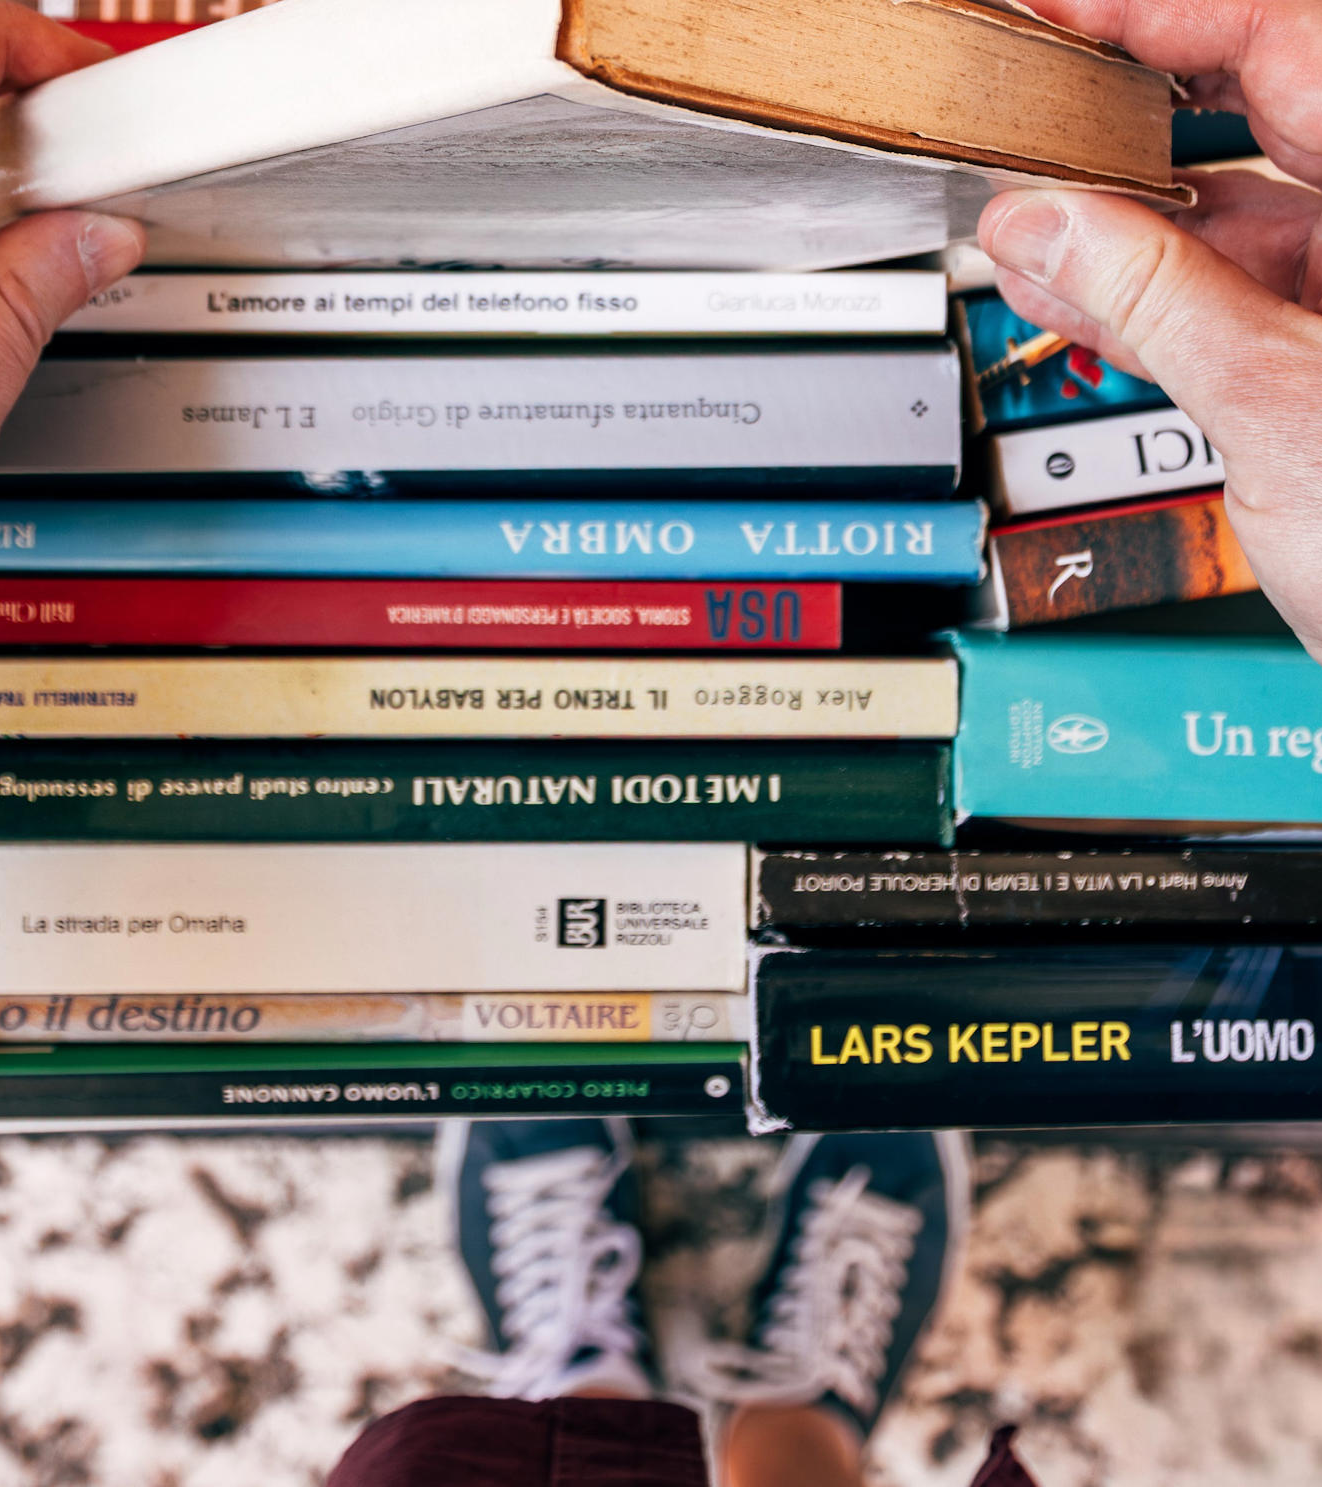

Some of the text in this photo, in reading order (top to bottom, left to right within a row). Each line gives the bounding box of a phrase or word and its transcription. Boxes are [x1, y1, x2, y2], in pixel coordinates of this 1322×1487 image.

[207, 288, 639, 319] L'amore ai tempi del telefono fisso
[181, 401, 265, 425] James
[297, 405, 316, 429] E
[351, 398, 764, 429] Cinquanta sfumature di Grigio
[498, 519, 936, 558] RIOTTA OMBRA
[39, 599, 75, 627] Bill
[468, 603, 559, 629] PERSONAGGI
[705, 588, 803, 642] USA
[31, 687, 137, 709] FELTRINELLI
[368, 686, 670, 712] IL TRENO PER BABYLON
[694, 685, 875, 716] Alex Roggero
[1180, 713, 1260, 757] Un
[125, 777, 153, 804] di
[159, 773, 243, 799] pavese
[248, 776, 310, 804] studi
[317, 775, 395, 800] centro
[411, 773, 760, 807] METODI NATURALI
[794, 872, 864, 893] POIROT
[870, 872, 955, 893] HERCULE
[984, 872, 1039, 893] TEMPI
[1071, 872, 1116, 893] VITA
[1119, 872, 1143, 893] LA
[1158, 872, 1197, 892] Hart
[1204, 872, 1248, 894] Anne
[615, 901, 701, 916] BIBLIOTECA
[22, 914, 45, 936] La
[49, 914, 120, 936] strada
[126, 918, 164, 942] per
[168, 914, 246, 936] Omaha
[615, 917, 708, 932] UNIVERSALE
[615, 933, 672, 947] RIZZOLI
[43, 995, 78, 1033] il
[87, 993, 262, 1034] destino
[474, 1001, 641, 1032] VOLTAIRE
[809, 1021, 1132, 1065] LARS KEPLER
[1169, 1018, 1315, 1063] L'UOMO
[221, 1082, 441, 1104] L'UOMO CANNONE
[451, 1080, 650, 1102] PIERO COLAPRICO
